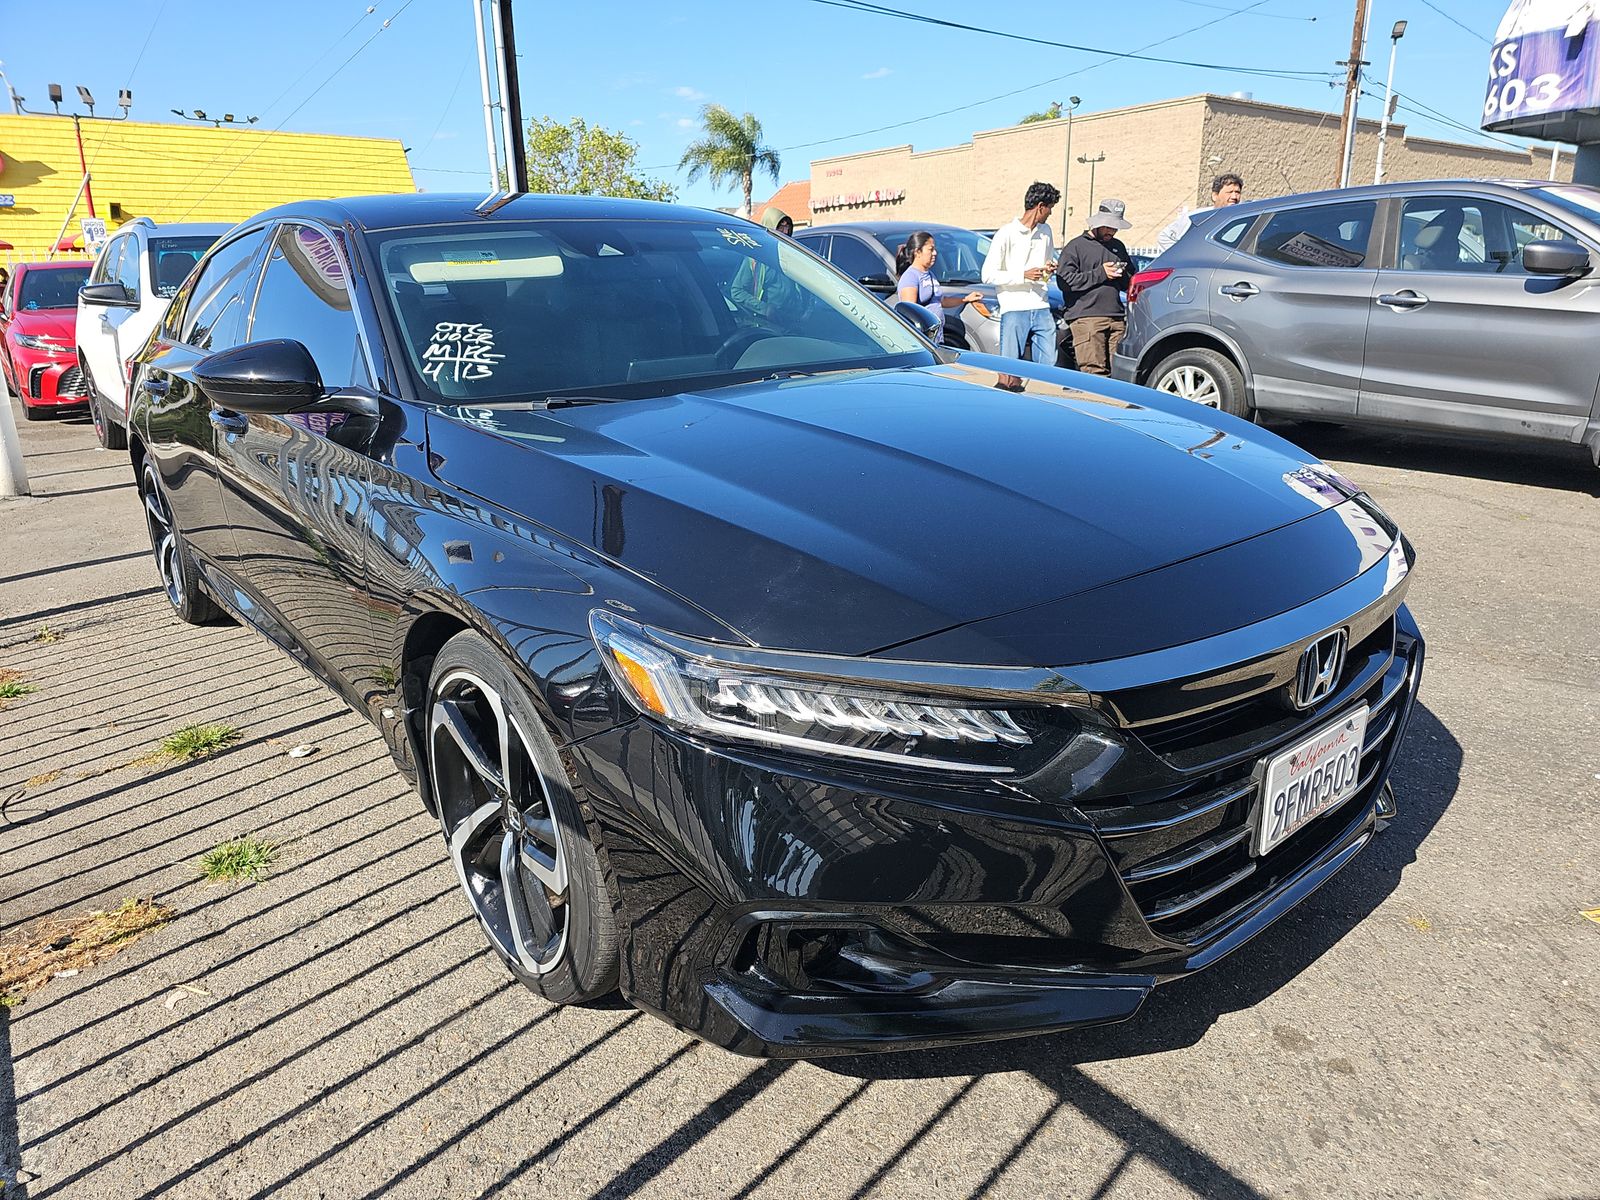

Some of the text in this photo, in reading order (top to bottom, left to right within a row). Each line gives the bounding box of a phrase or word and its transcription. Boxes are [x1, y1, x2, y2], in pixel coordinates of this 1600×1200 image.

[875, 189, 905, 203] SHOP
[1290, 731, 1349, 776] California
[1271, 745, 1359, 840] 9FMR503
